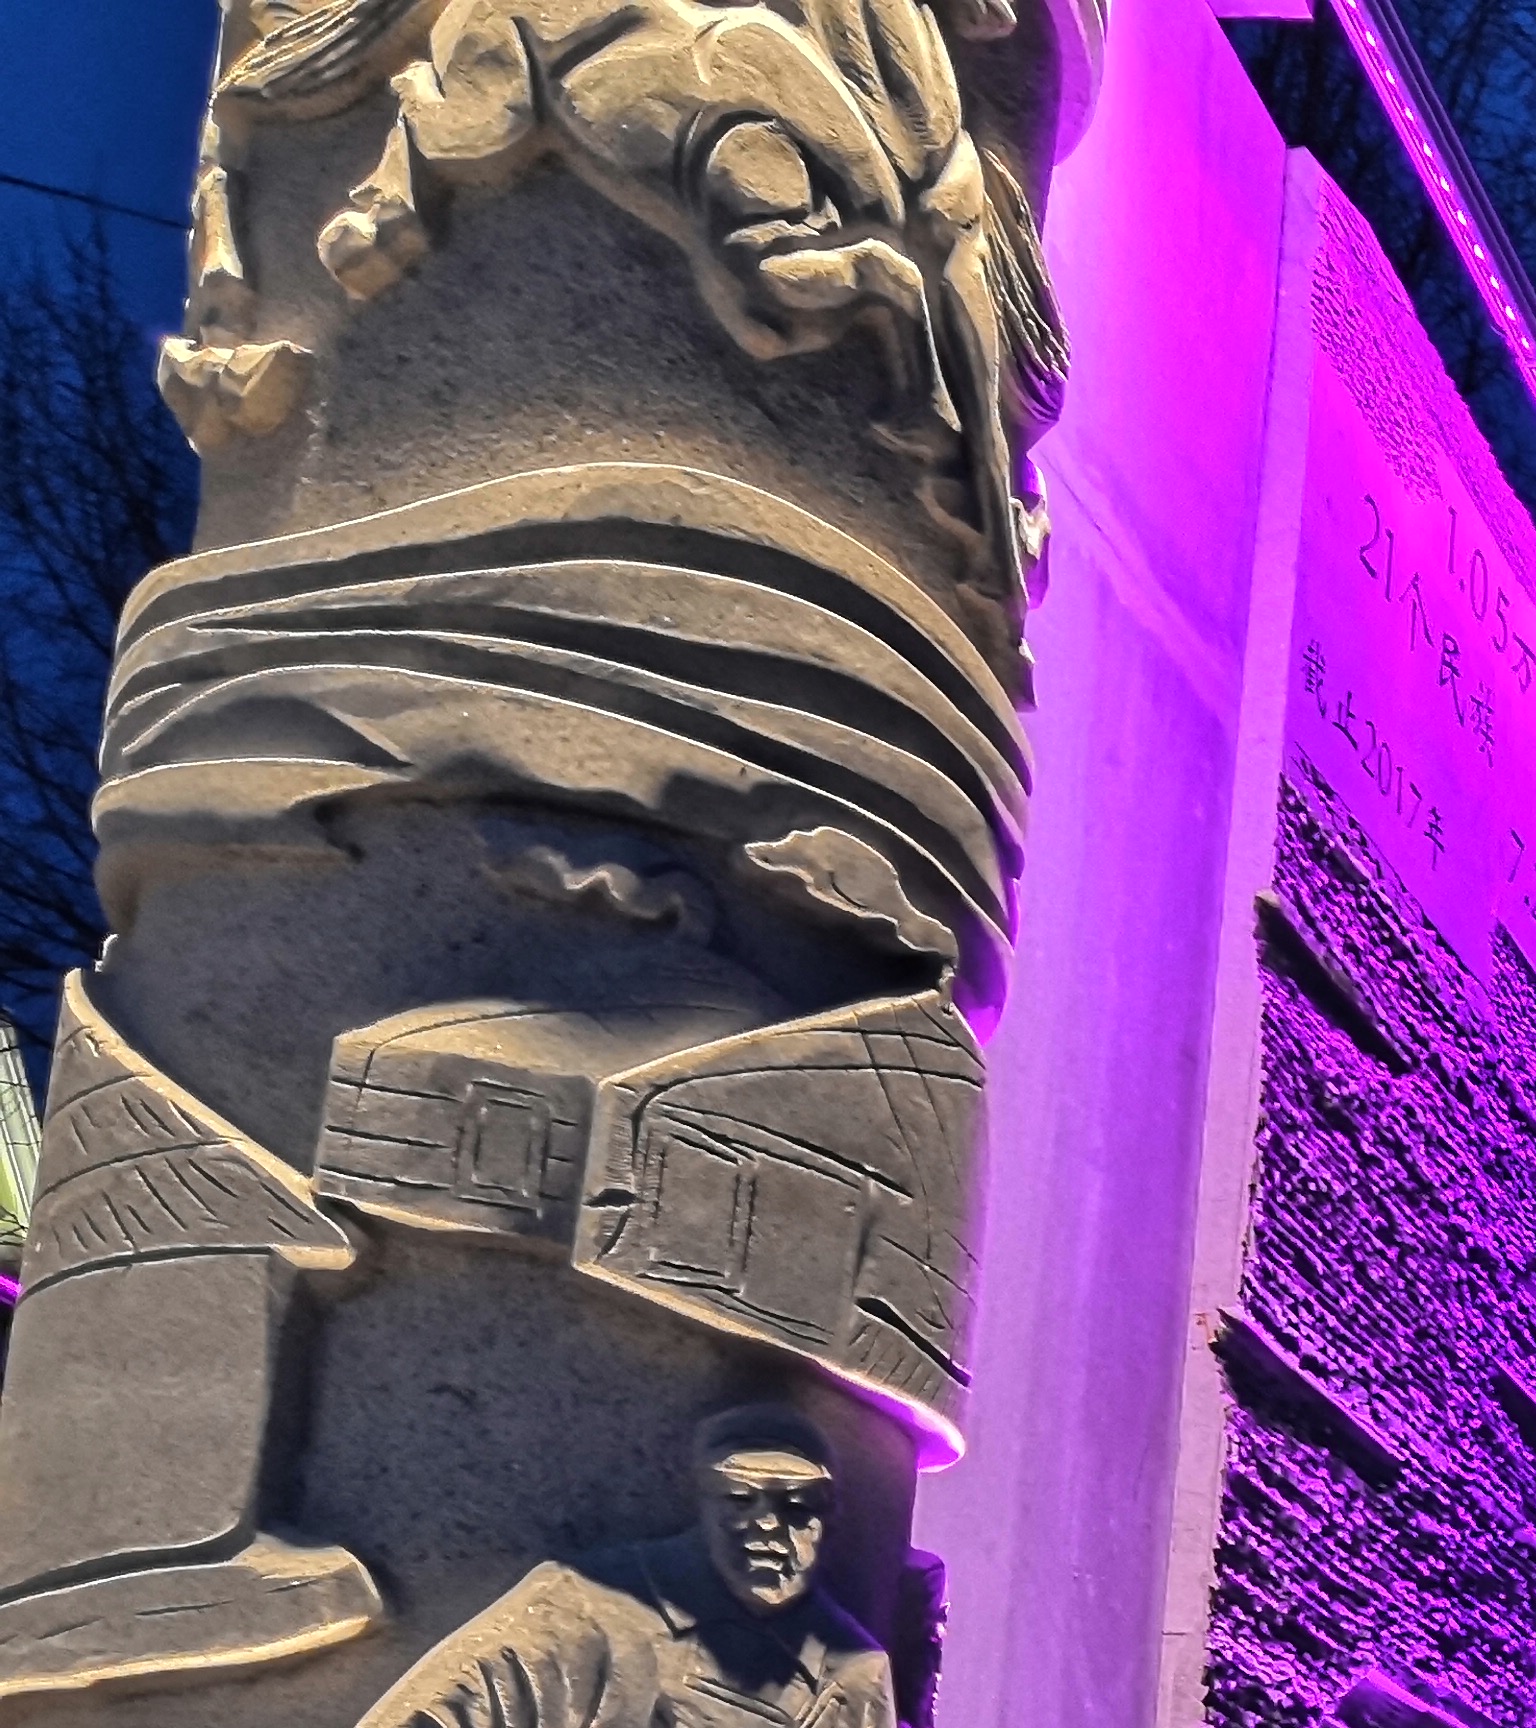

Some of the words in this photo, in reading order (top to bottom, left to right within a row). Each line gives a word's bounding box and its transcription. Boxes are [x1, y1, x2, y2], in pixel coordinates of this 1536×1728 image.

[1301, 636, 1446, 871] 截止2017年
[1358, 494, 1496, 768] 21个民族
